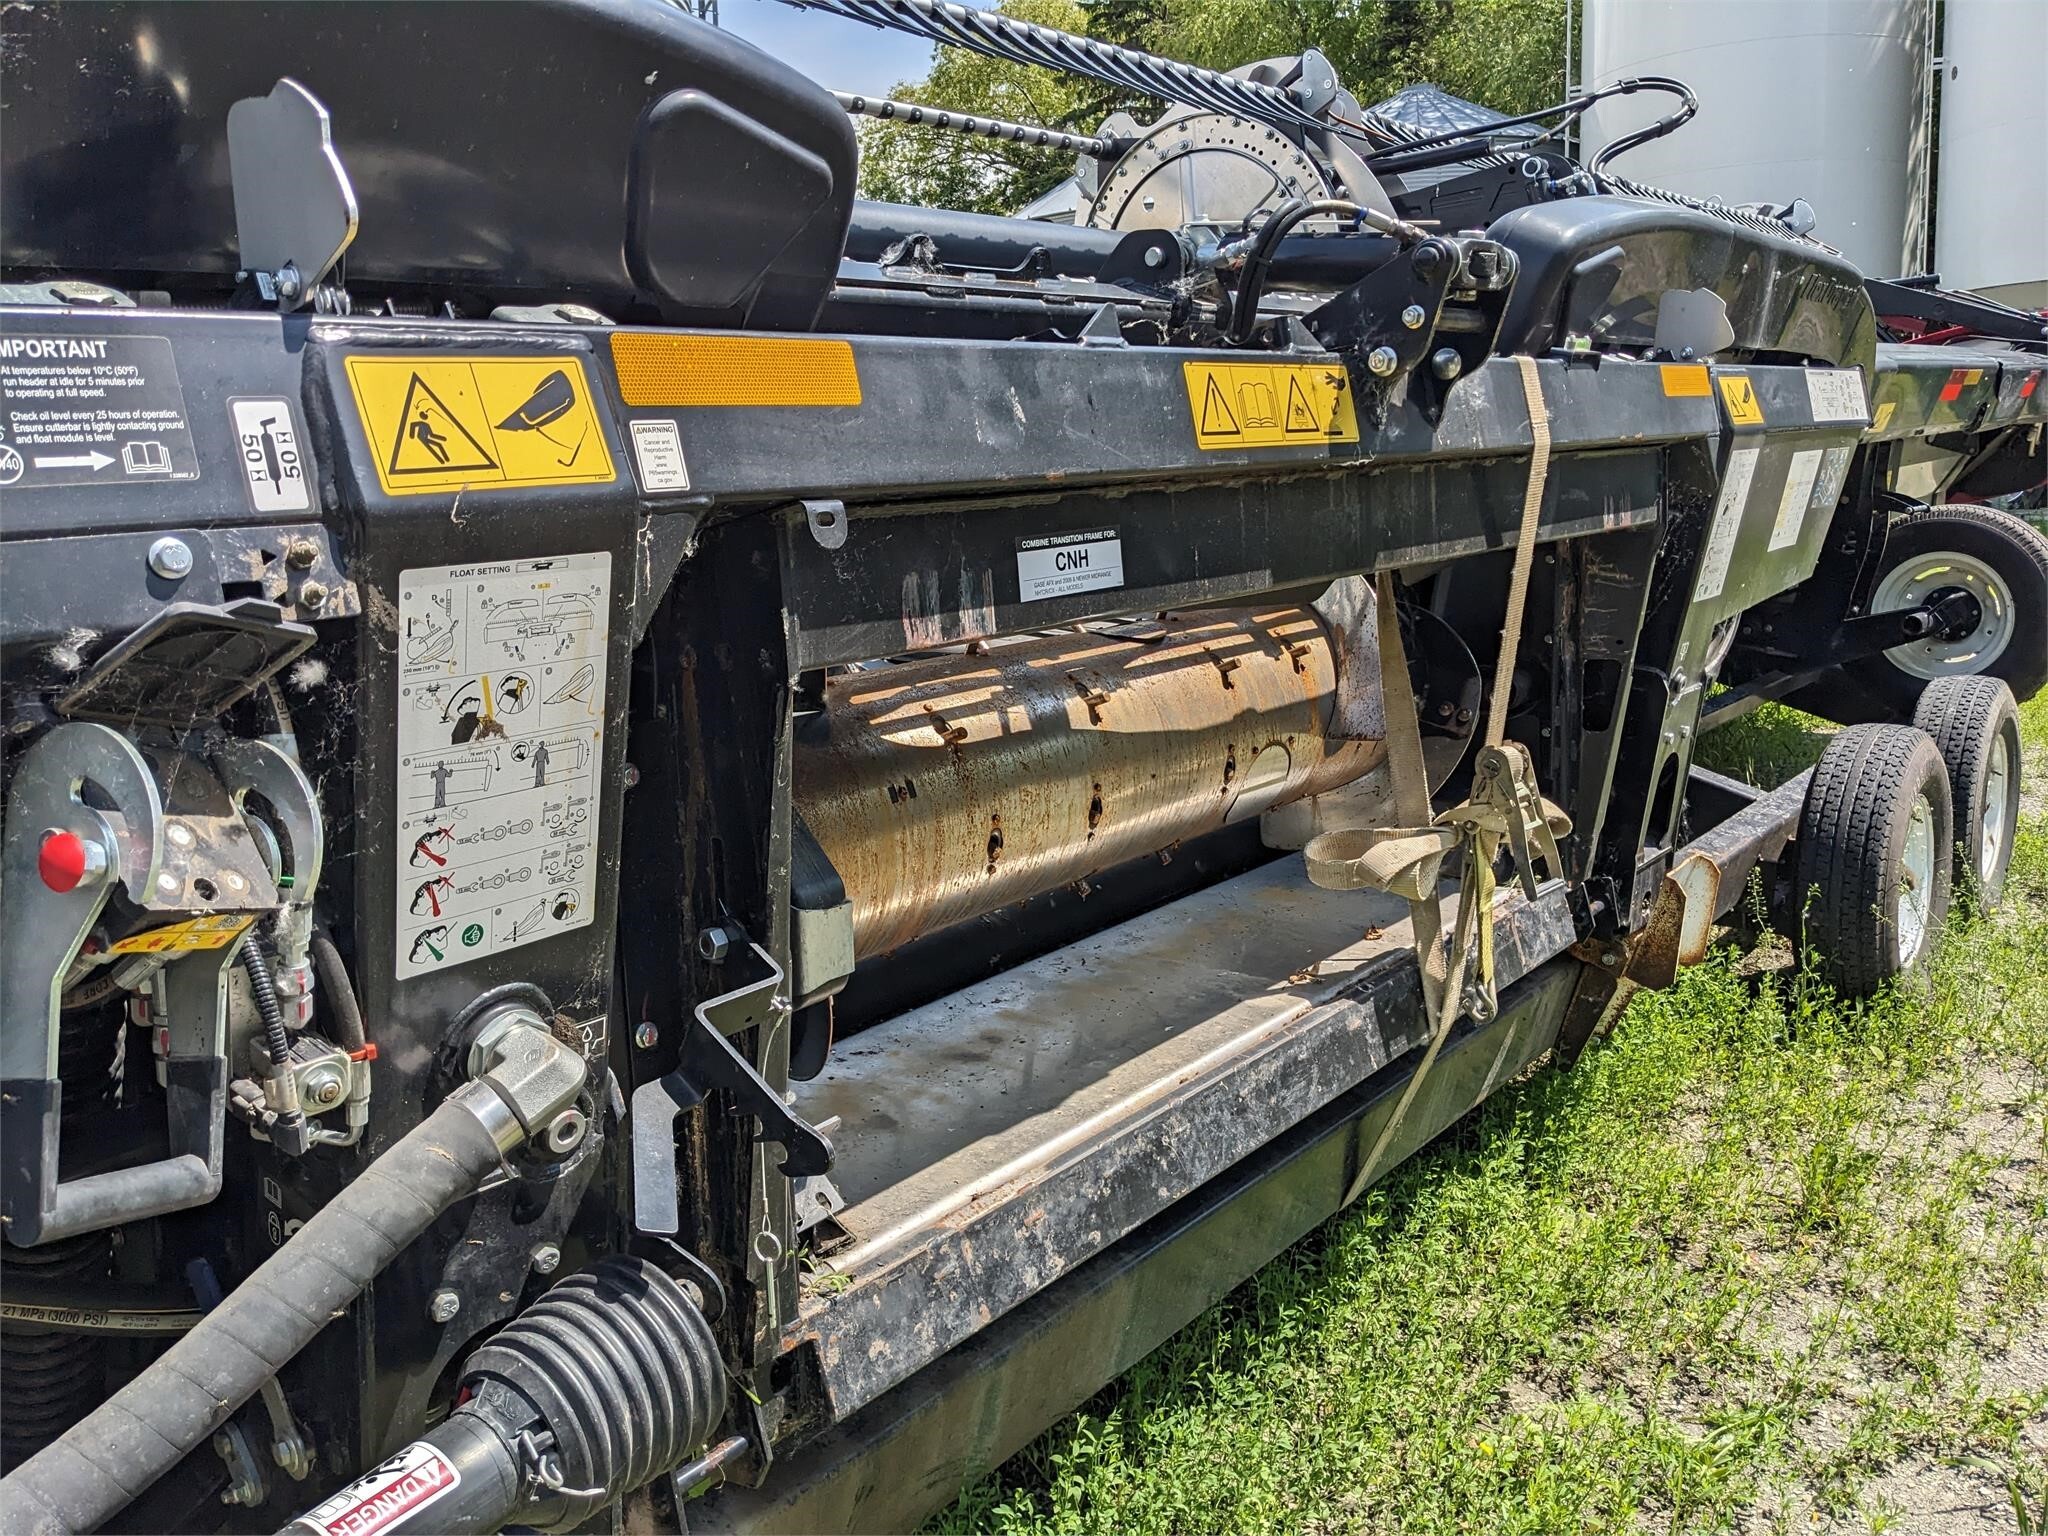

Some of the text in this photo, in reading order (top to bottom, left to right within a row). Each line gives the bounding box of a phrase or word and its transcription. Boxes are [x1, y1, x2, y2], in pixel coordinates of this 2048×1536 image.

[11, 366, 66, 377] temperatures
[67, 366, 91, 375] below
[3, 377, 145, 388] run header at idle for 5 minutes prior
[5, 388, 107, 399] to operating at full speed.
[11, 409, 180, 421] Check oil level every 25 hours of operation.
[13, 420, 184, 432] Ensure cutterbar is lightly contacting ground
[640, 426, 674, 434] WARNING
[16, 432, 116, 443] and float module is level.
[242, 434, 263, 462] 50
[281, 450, 301, 479] 50
[1022, 529, 1117, 548] COMBINE TRANSITION FRAME FOR:
[1055, 549, 1090, 571] CNH
[449, 566, 511, 578] FLOAT SETTING
[3, 1305, 17, 1316] 21
[20, 1307, 45, 1320] MPa
[47, 1309, 80, 1323] (3000
[82, 1312, 108, 1326] PSI)
